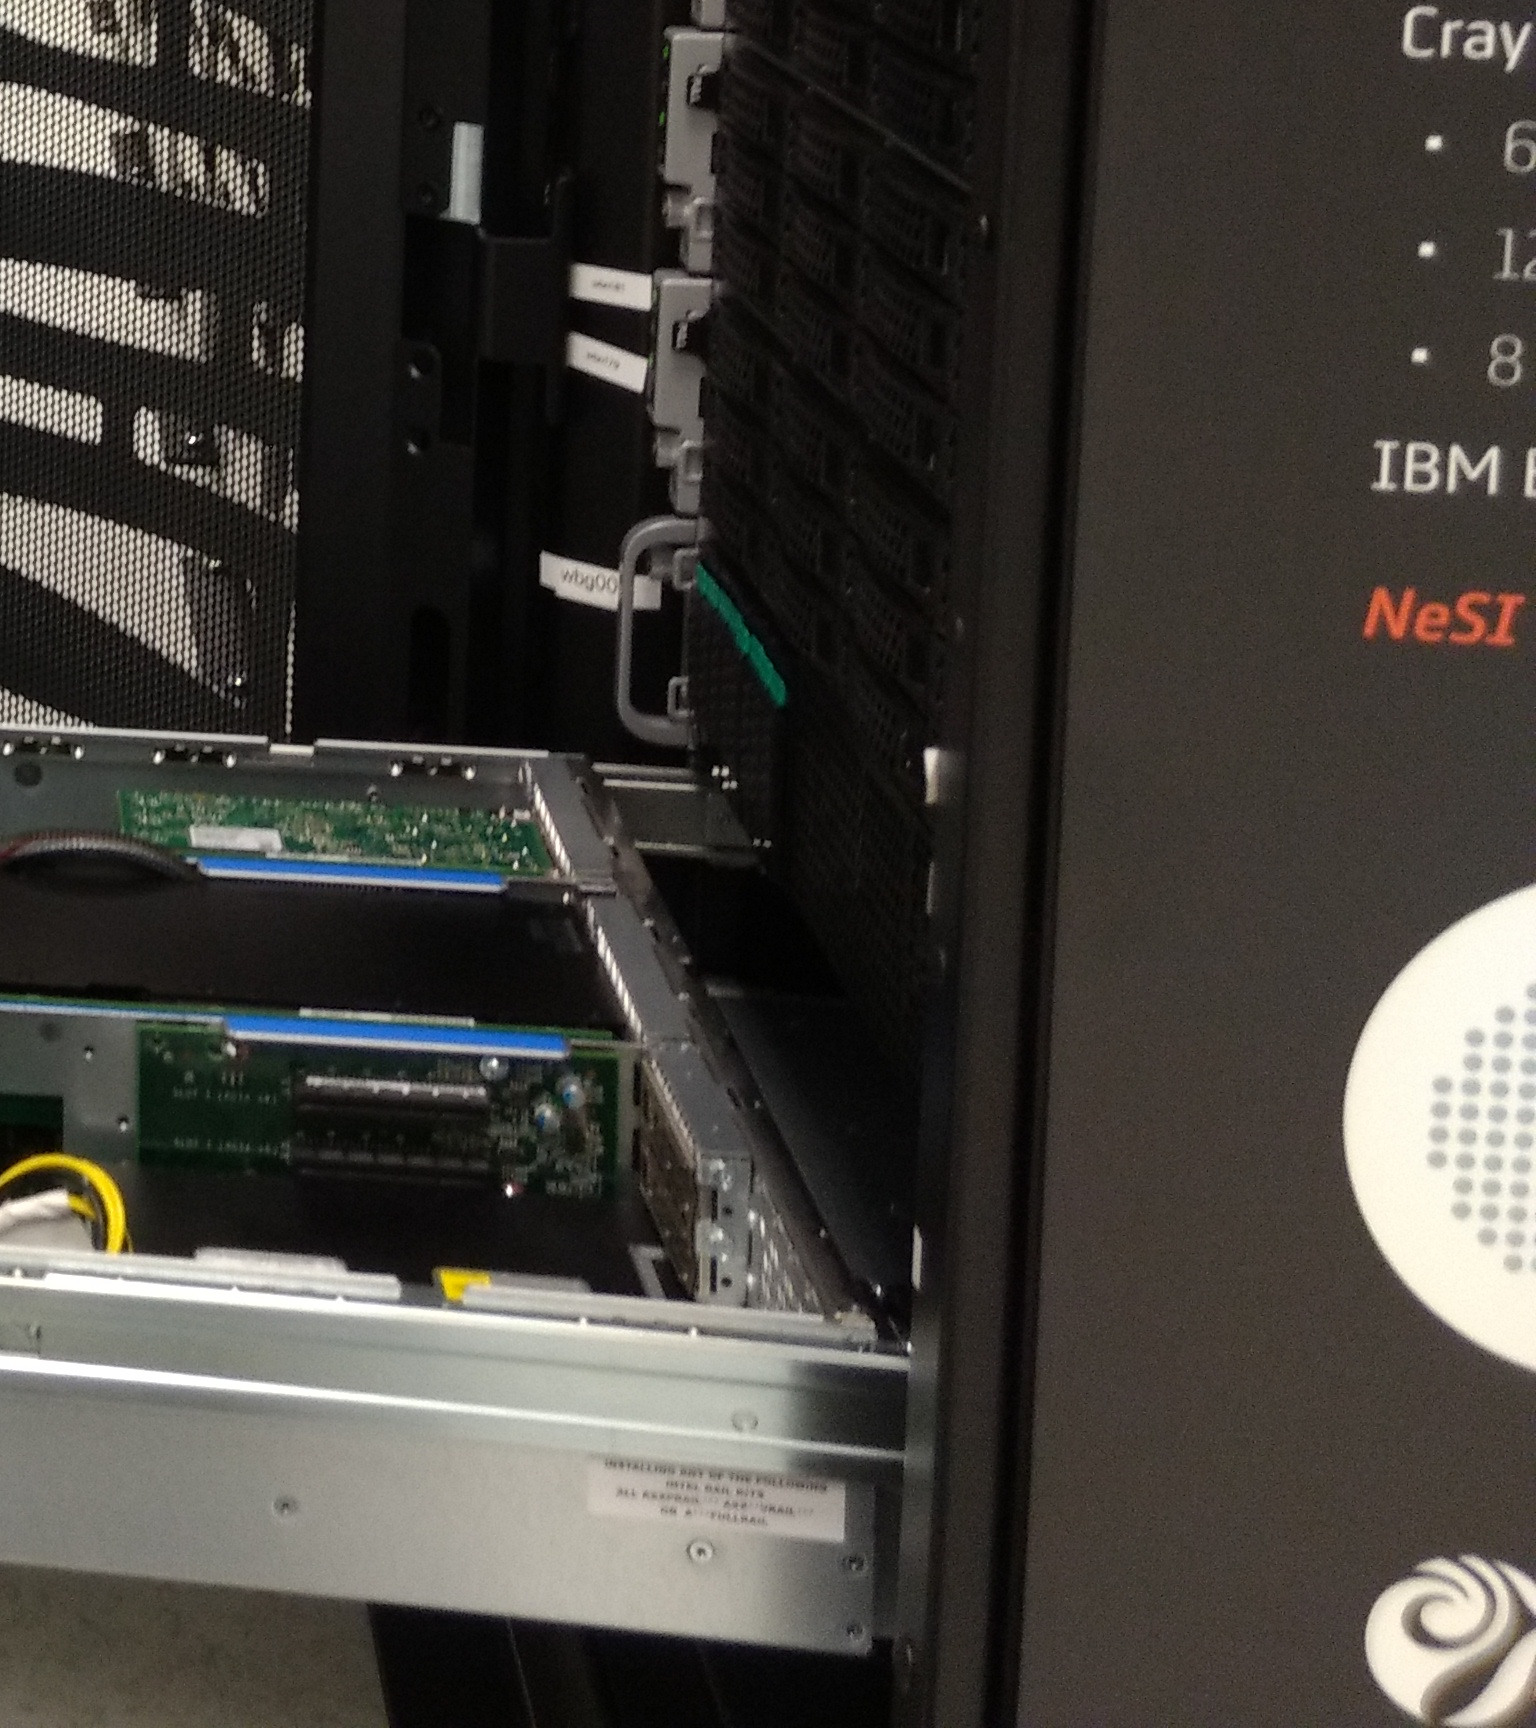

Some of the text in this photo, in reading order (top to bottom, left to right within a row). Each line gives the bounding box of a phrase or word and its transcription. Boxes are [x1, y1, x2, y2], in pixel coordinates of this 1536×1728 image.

[1401, 4, 1533, 74] Cray
[1503, 119, 1536, 173] 6
[1486, 333, 1523, 387] 8
[1370, 438, 1502, 498] IBM
[1362, 584, 1526, 647] NeSI
